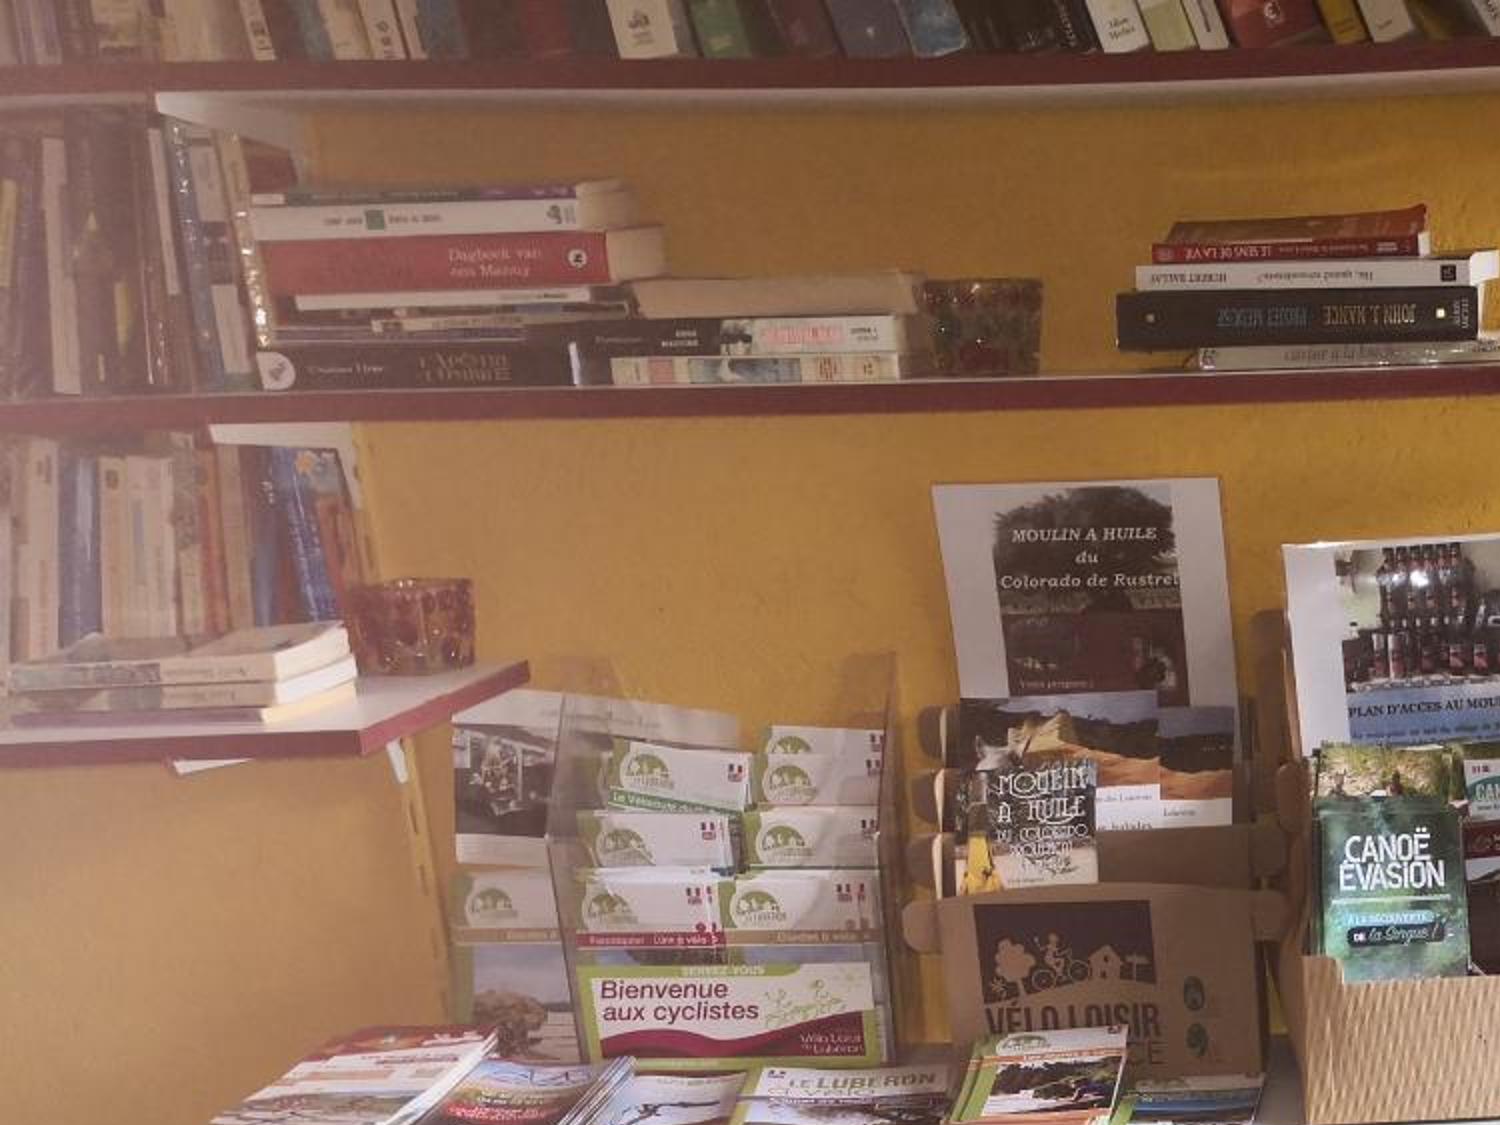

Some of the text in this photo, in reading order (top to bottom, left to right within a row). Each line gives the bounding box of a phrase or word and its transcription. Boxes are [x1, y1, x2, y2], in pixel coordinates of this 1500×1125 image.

[1012, 526, 1157, 543] MOULIN A HUILE
[1075, 550, 1099, 564] du
[1001, 573, 1081, 590] Colorado
[1086, 573, 1108, 588] de
[1348, 704, 1386, 718] PLAN
[1446, 698, 1466, 711] AU
[1344, 827, 1432, 864] CANOË
[600, 979, 729, 1001] Bienvenue
[603, 1001, 760, 1026] aux cyclistes
[817, 1073, 937, 1090] LUBERON
